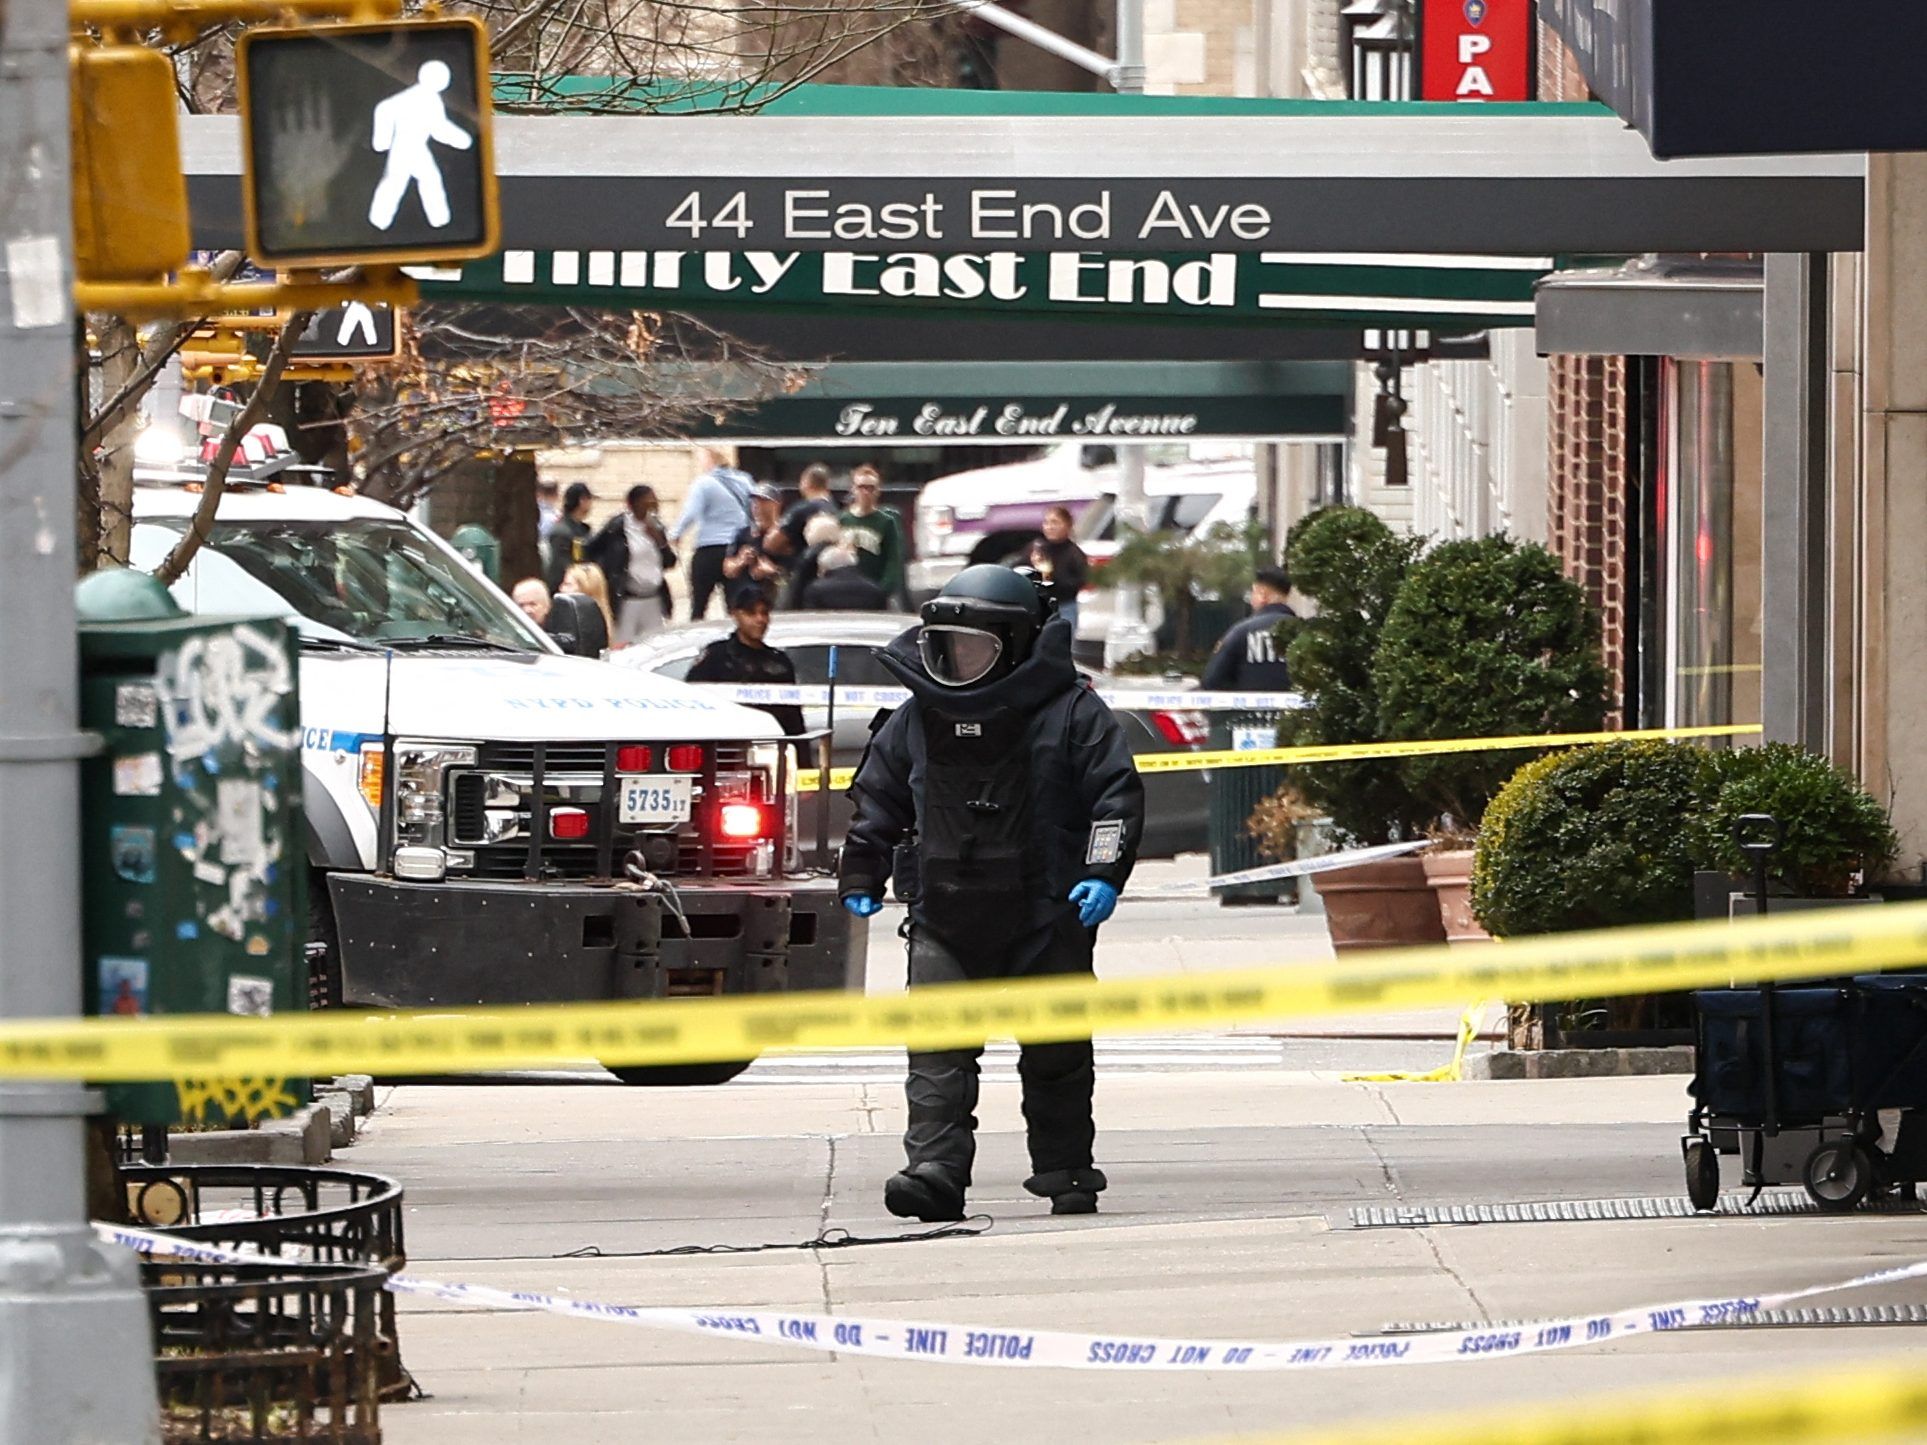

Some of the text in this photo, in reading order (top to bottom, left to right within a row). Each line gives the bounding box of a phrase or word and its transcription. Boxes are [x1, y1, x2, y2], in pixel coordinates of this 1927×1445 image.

[1455, 34, 1494, 103] PA
[665, 189, 1272, 239] 44 East End Ave
[823, 251, 1027, 299] East
[1049, 251, 1237, 306] End
[835, 402, 1197, 436] Ten East End Avenue
[504, 698, 716, 711] NYPD POLICE
[627, 789, 671, 811] 5735
[779, 1319, 817, 1342] NOT
[834, 1323, 863, 1346] DO
[905, 1329, 948, 1354] LINE
[1535, 1326, 1572, 1347] NOT
[963, 1332, 1034, 1360] POLICE
[1086, 1341, 1157, 1364] CROSS
[1166, 1345, 1211, 1364] NOT
[1222, 1346, 1254, 1364] DO
[1287, 1346, 1332, 1363] LINE
